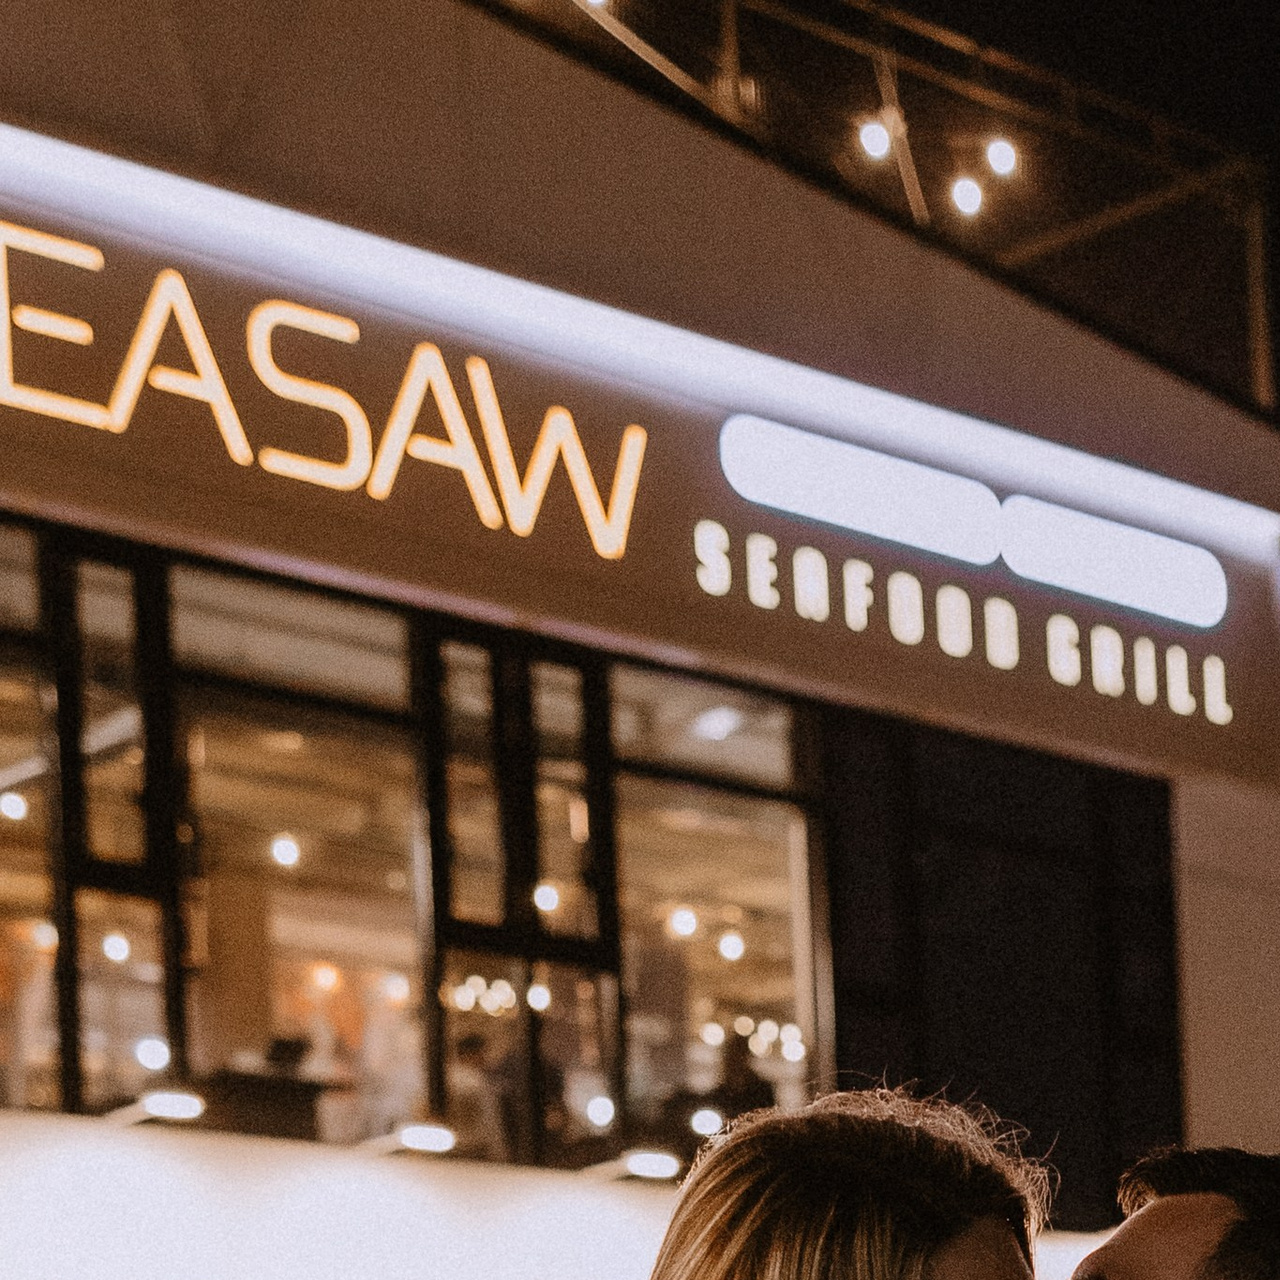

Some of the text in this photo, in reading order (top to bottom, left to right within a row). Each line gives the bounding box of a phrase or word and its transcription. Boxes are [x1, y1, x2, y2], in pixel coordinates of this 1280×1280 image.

[0, 220, 648, 560] EASAW
[693, 518, 1234, 726] SEAFOOD GRILL
